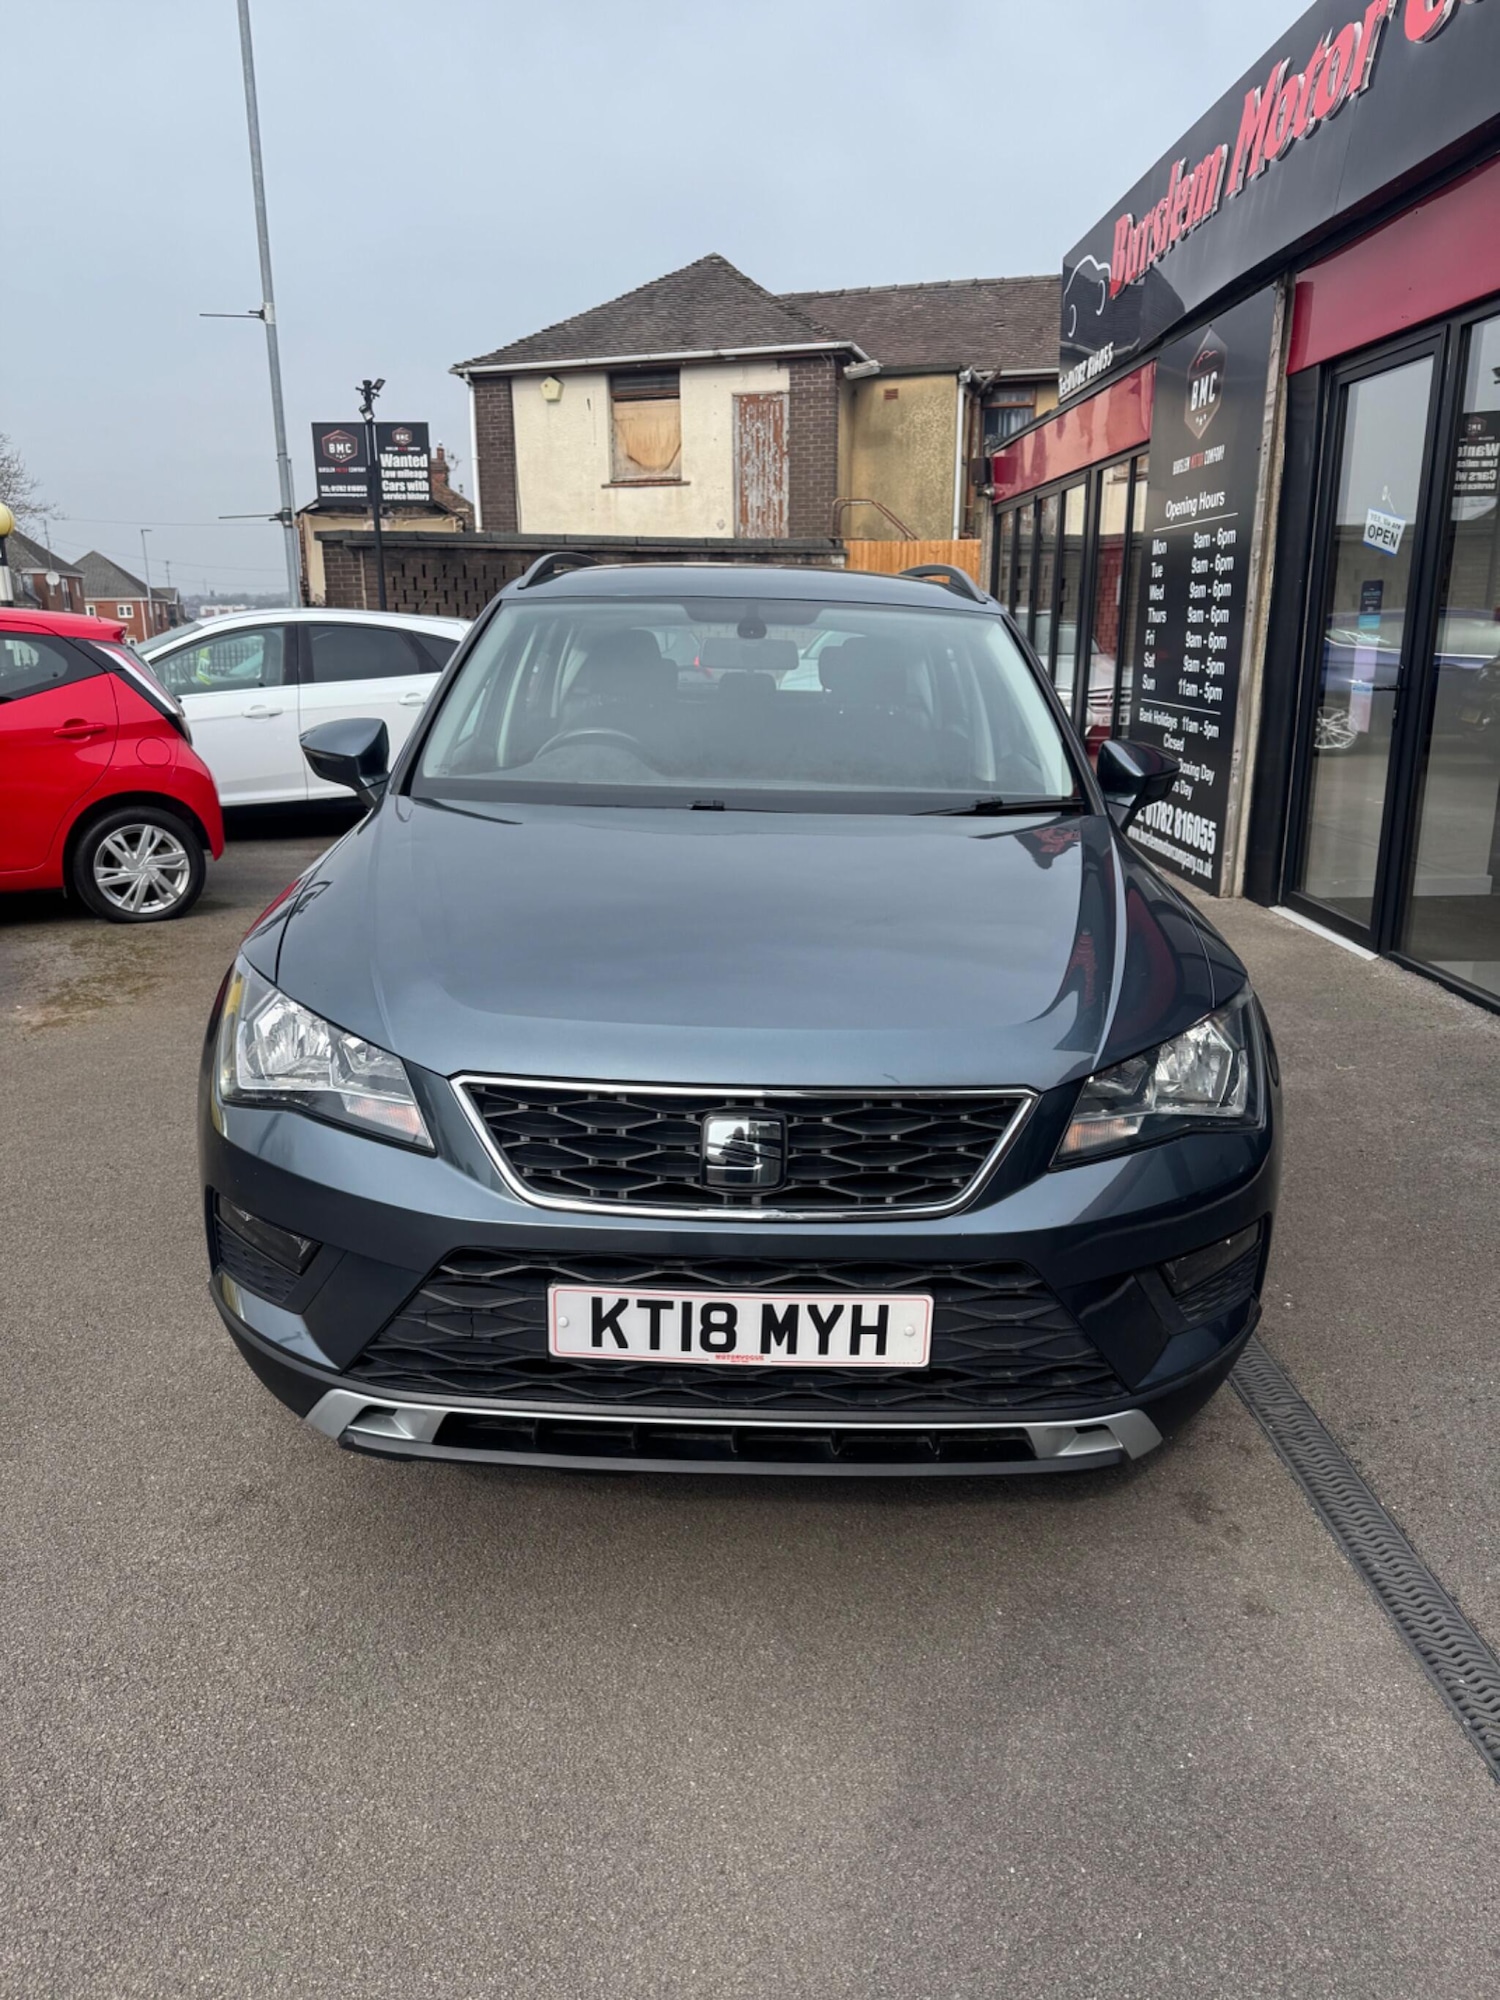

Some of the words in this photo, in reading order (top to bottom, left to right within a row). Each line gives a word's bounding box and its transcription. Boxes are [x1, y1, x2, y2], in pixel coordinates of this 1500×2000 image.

[1109, 144, 1228, 299] Burslem
[1225, 0, 1396, 199] Motor
[1190, 371, 1218, 411] BMC
[328, 443, 352, 453] BMC
[380, 453, 428, 467] Wanted
[381, 469, 396, 478] Low
[397, 469, 428, 479] mileage
[382, 480, 406, 491] Cars
[406, 480, 429, 491] with
[1165, 495, 1198, 521] Opening
[1198, 490, 1225, 510] Hours
[1152, 539, 1167, 555] Mon
[1193, 531, 1210, 549] 9am
[1217, 527, 1236, 550] 6pm
[1367, 524, 1399, 548] OPEN
[1151, 562, 1164, 578] Tue
[1191, 556, 1208, 574] 9am
[1214, 553, 1234, 576] 6pm
[1149, 584, 1165, 600] Wed
[1189, 581, 1206, 599] 9am
[1212, 579, 1232, 602] 6pm
[1147, 607, 1167, 623] Thurs
[1187, 606, 1204, 623] 9am
[1210, 605, 1229, 627] 6pm
[1145, 629, 1155, 645] Fri
[1185, 630, 1202, 648] 9am
[1208, 631, 1227, 654] 6pm
[1143, 651, 1155, 668] Sat
[1182, 654, 1200, 672] 9am
[1205, 656, 1225, 679] 5pm
[1142, 673, 1156, 690] Sun
[1178, 678, 1198, 697] 11am
[1203, 681, 1223, 704] 5pm
[1139, 707, 1153, 722] Bank
[1153, 709, 1178, 731] Holidays
[1182, 716, 1199, 734] 11am
[1203, 720, 1219, 740] 5pm
[1163, 733, 1185, 752] Closed
[1201, 763, 1215, 786] Day
[1180, 779, 1194, 801] Day
[1145, 800, 1173, 836] 01782
[1174, 808, 1217, 855] 816055
[591, 1296, 738, 1353] KT18
[760, 1303, 890, 1356] MYH
